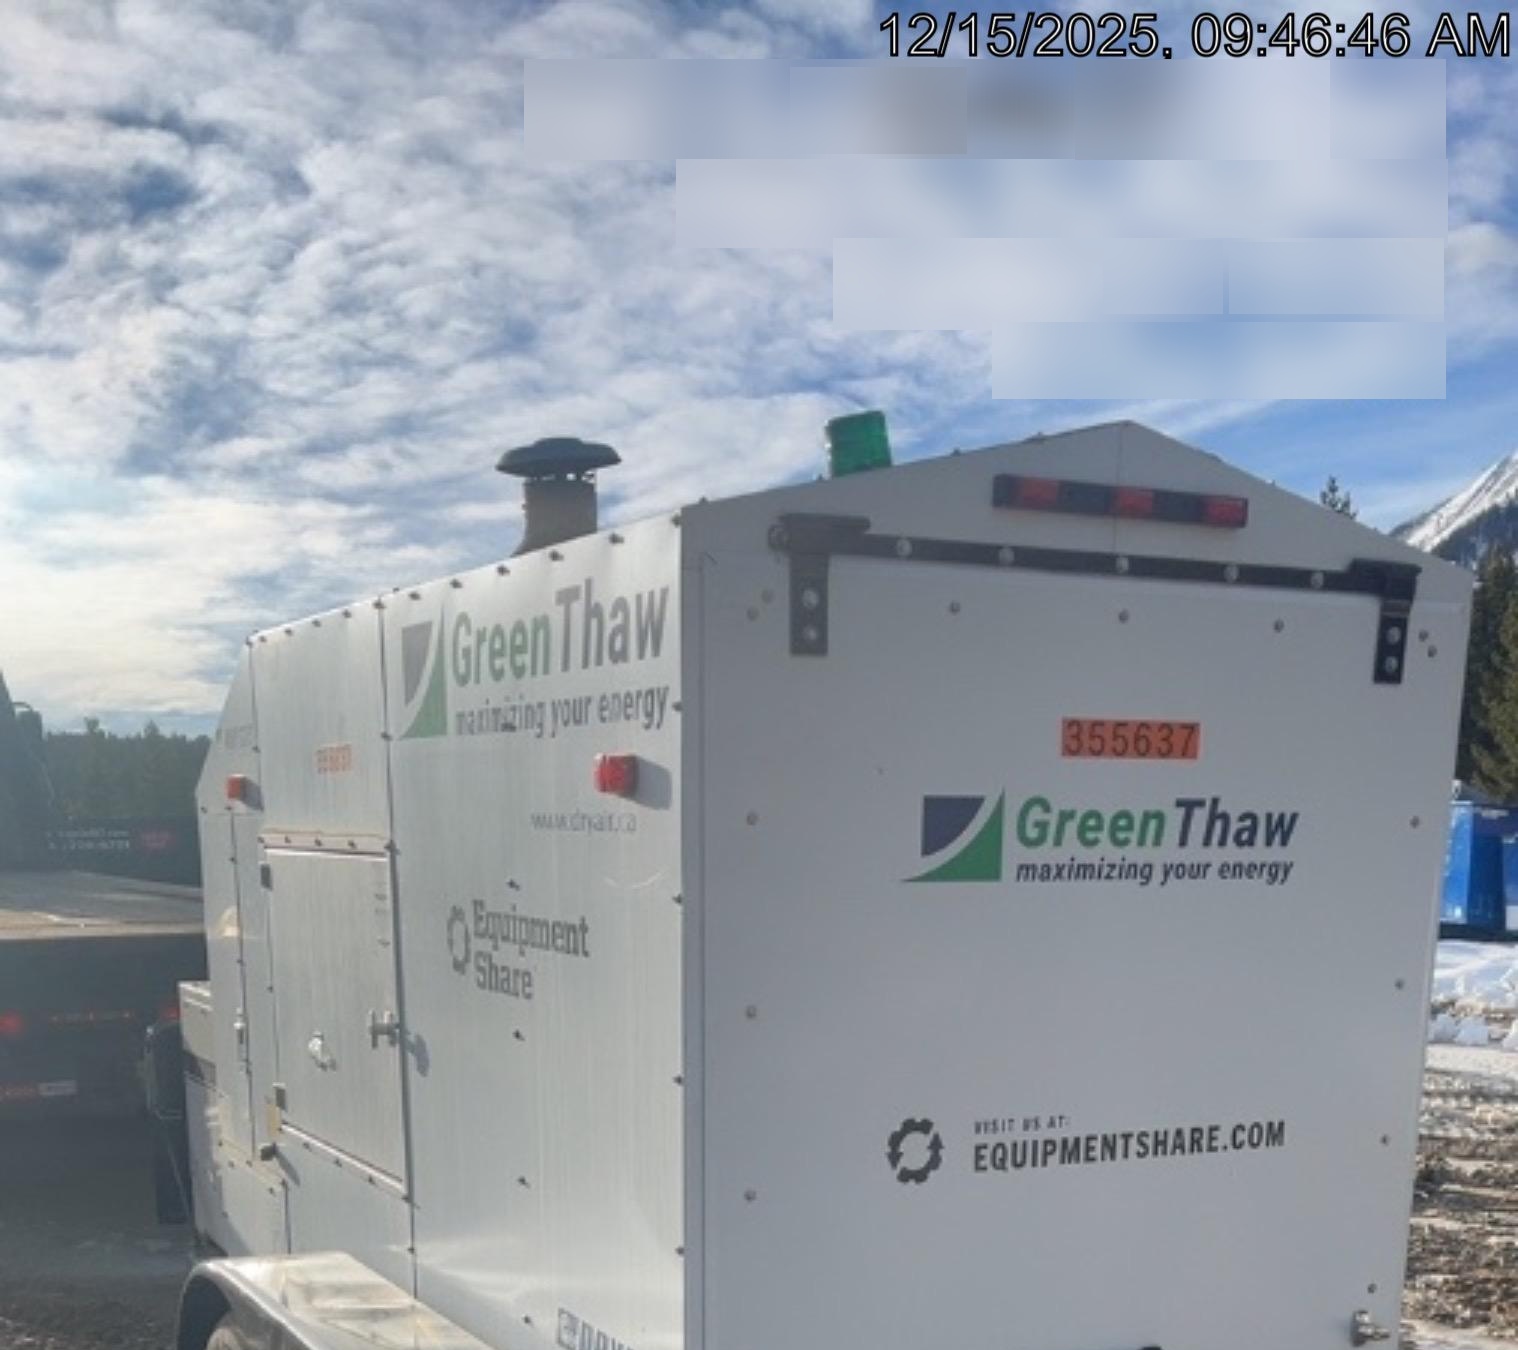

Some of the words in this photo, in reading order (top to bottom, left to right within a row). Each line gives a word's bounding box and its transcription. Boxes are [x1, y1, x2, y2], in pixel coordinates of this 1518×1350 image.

[455, 693, 547, 738] maximizing
[551, 698, 592, 739] your
[598, 686, 669, 731] energy
[1064, 719, 1197, 758] 355637
[1015, 857, 1153, 886] maximizing
[1160, 861, 1212, 886] your
[1217, 861, 1293, 886] energy
[473, 899, 590, 958] Equipment
[474, 950, 534, 1000] Share
[973, 1120, 1286, 1172] EQUIPMENTSHARE.COM
[974, 1118, 1015, 1135] VISIT
[1022, 1116, 1041, 1132] US
